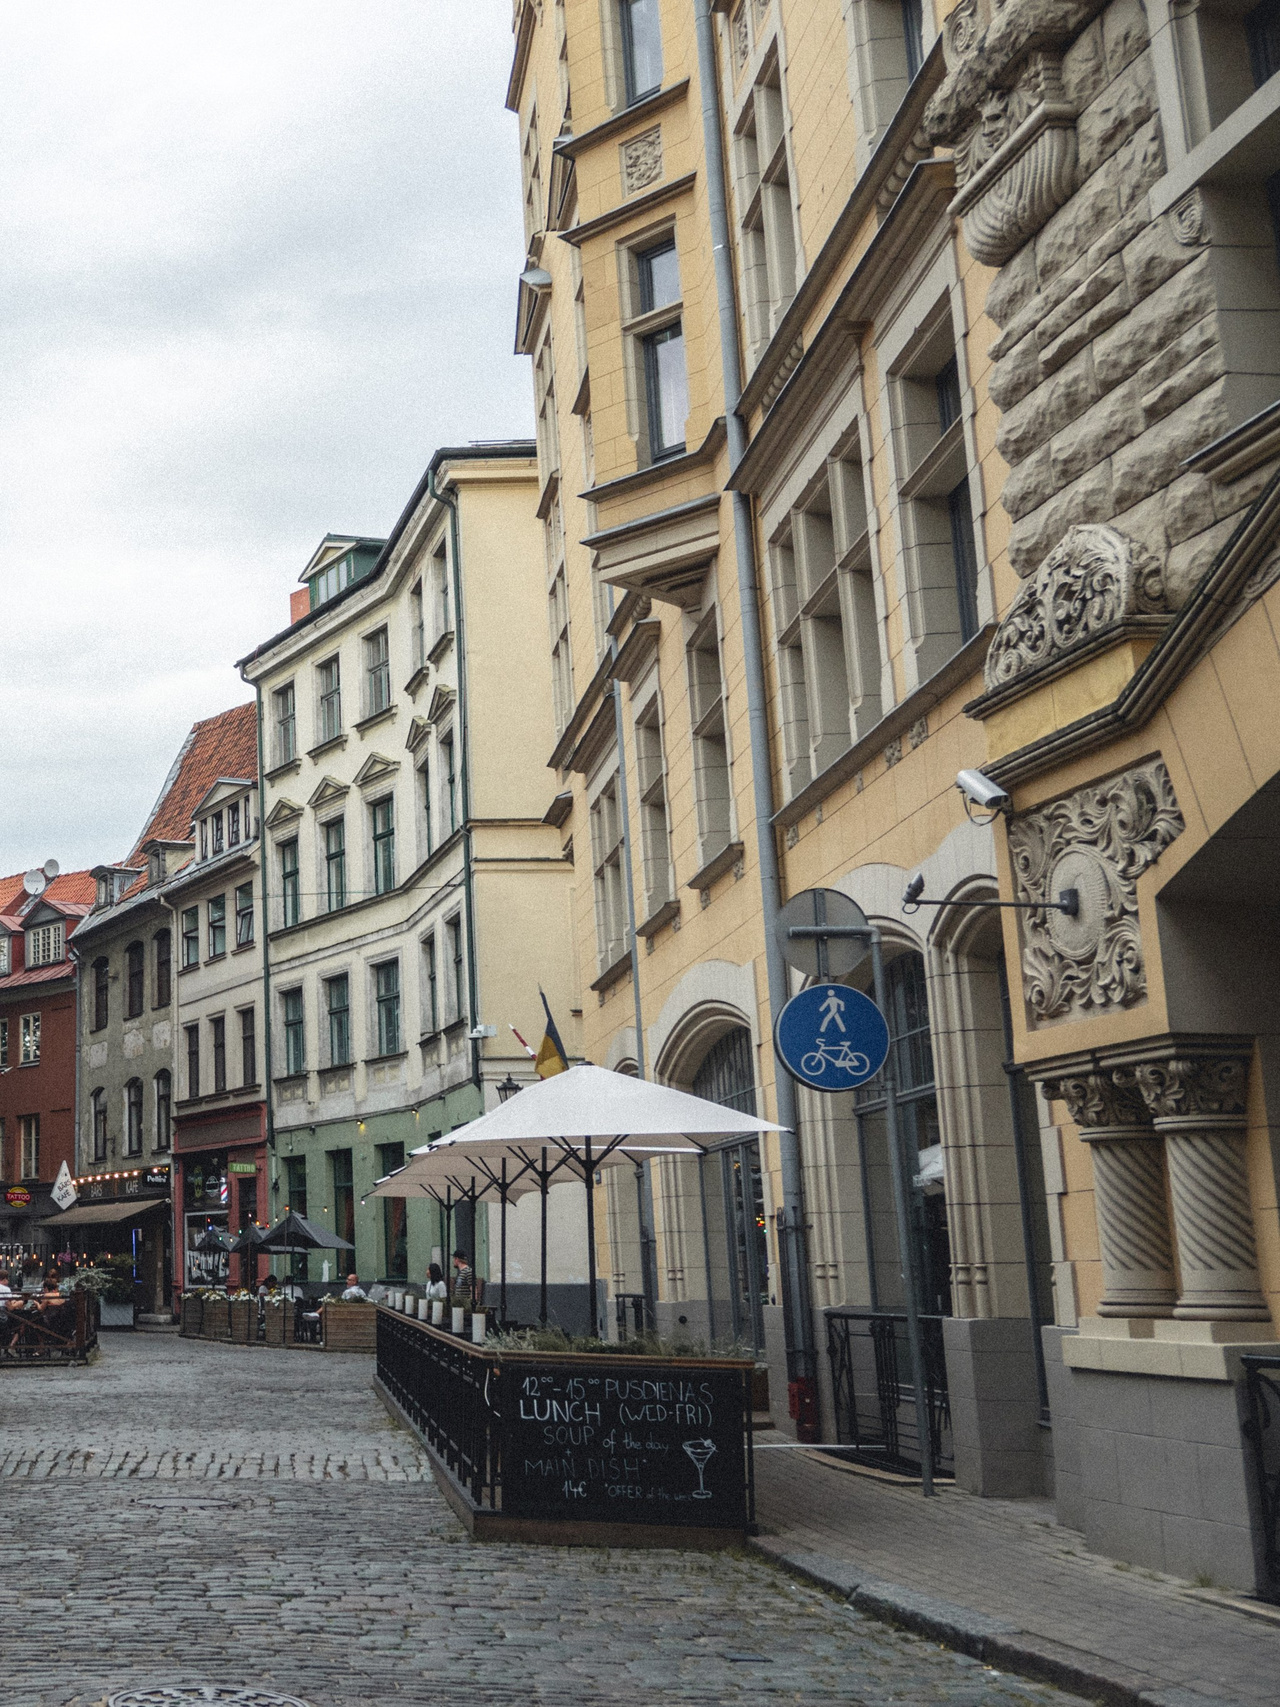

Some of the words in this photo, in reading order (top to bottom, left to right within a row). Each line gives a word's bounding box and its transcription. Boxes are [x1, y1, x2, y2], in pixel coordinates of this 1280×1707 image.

[6, 1193, 31, 1201] TATTOO
[605, 1379, 714, 1405] PUSDIENAS
[520, 1399, 600, 1426] LUNCH
[619, 1400, 712, 1428] (WED-FRI)
[543, 1425, 595, 1446] SOUP
[602, 1428, 617, 1455] of
[622, 1431, 642, 1450] the
[645, 1431, 670, 1456] day
[524, 1458, 576, 1478] MAIN
[562, 1480, 587, 1499] 14€
